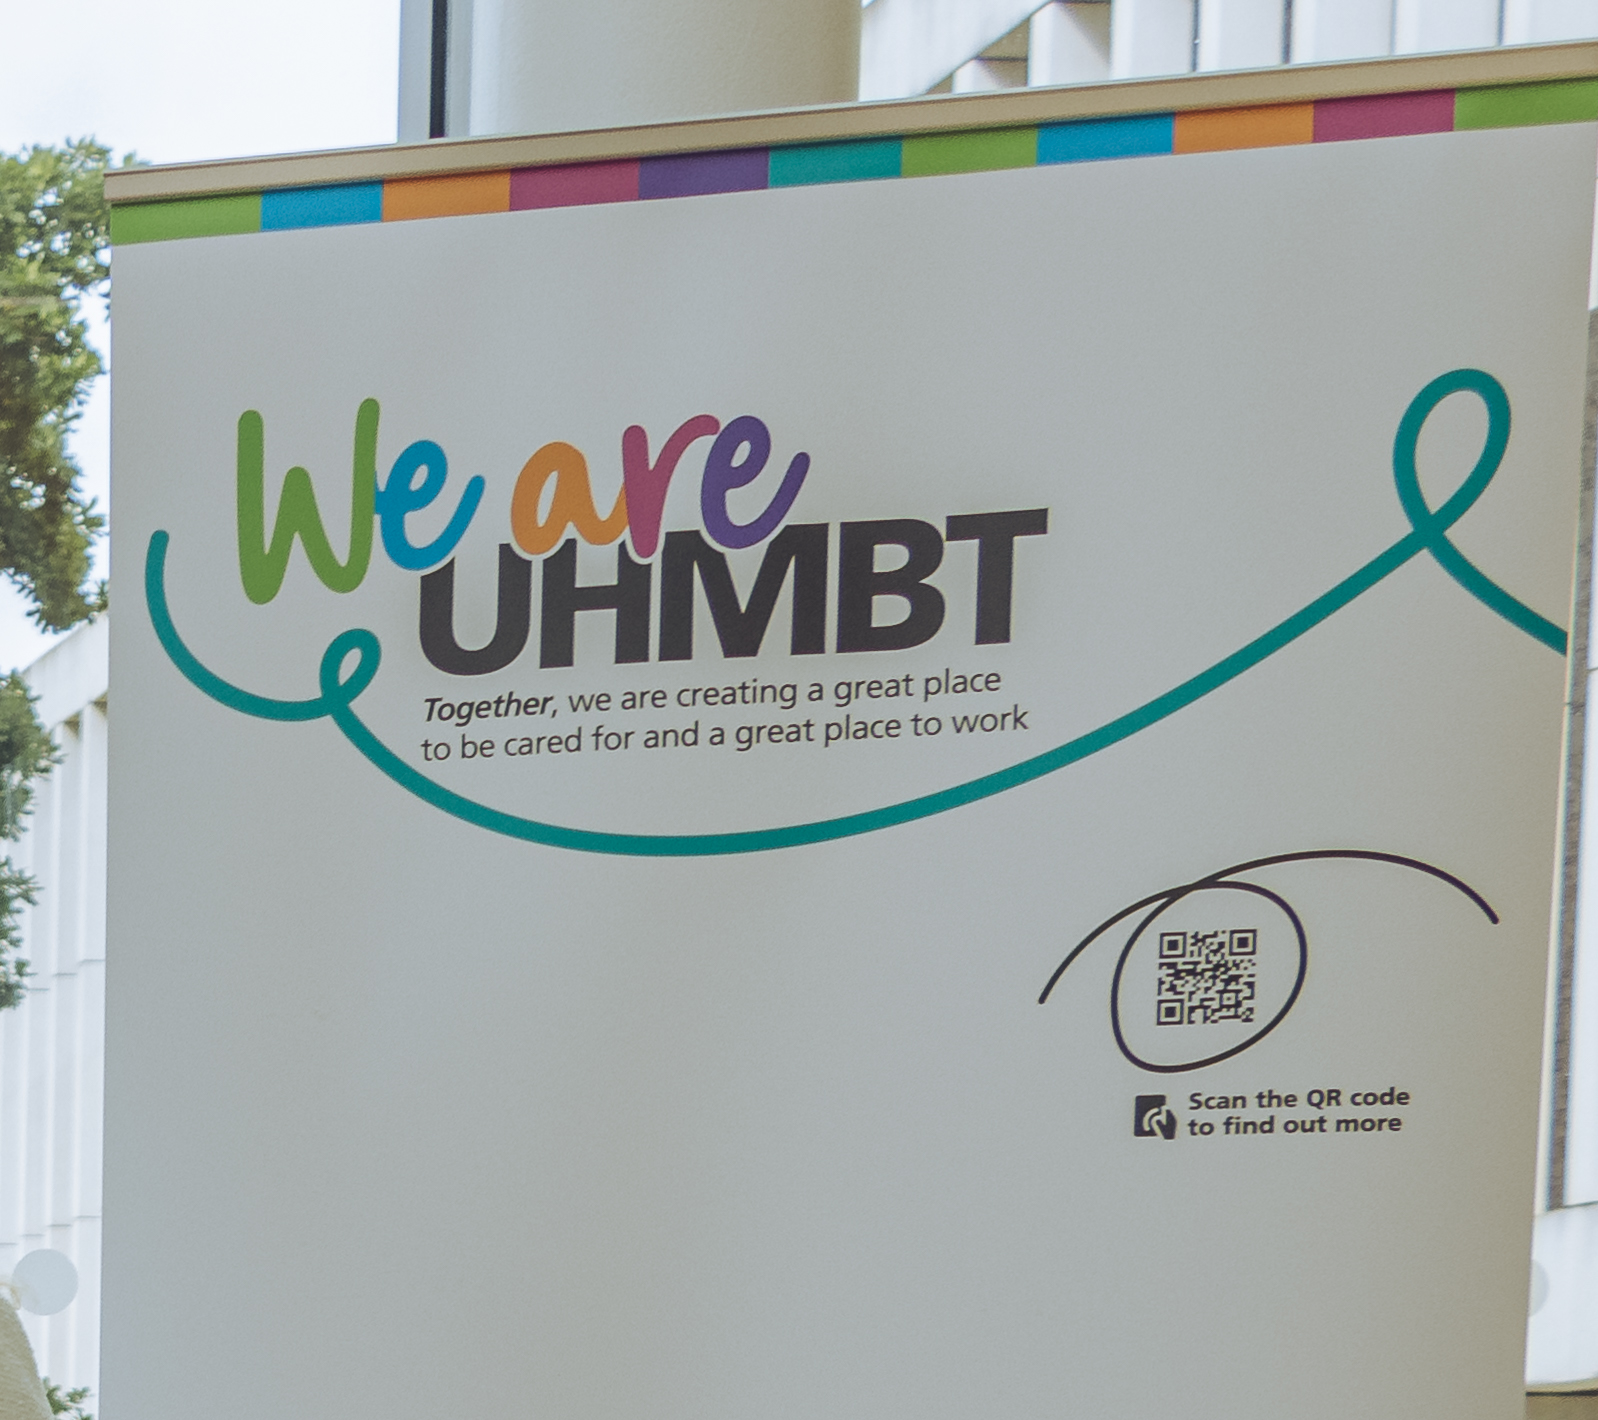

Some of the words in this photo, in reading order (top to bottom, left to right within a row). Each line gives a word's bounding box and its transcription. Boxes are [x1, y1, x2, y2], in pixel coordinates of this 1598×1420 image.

[236, 397, 486, 606] We
[510, 413, 811, 558] are
[418, 506, 1049, 677] UHMBT
[423, 692, 559, 726] Together,
[569, 689, 612, 713] we
[621, 687, 666, 711] are
[676, 678, 797, 711] creating
[808, 682, 824, 703] a
[834, 673, 914, 709] great
[924, 667, 1003, 701] place
[420, 735, 451, 762] to
[461, 729, 496, 760] be
[504, 725, 582, 758] cared
[592, 724, 635, 752] for
[643, 720, 699, 749] and
[708, 725, 725, 747] a
[735, 716, 815, 753] great
[824, 712, 902, 748] place
[911, 713, 942, 738] to
[953, 704, 1029, 735] work
[1187, 1118, 1214, 1136] to
[1223, 1115, 1275, 1135] find
[1283, 1115, 1327, 1134] out
[1335, 1116, 1402, 1132] more
[1188, 1092, 1247, 1111] Scan
[1255, 1088, 1298, 1109] the
[1306, 1088, 1342, 1110] QR
[1350, 1086, 1410, 1107] code
